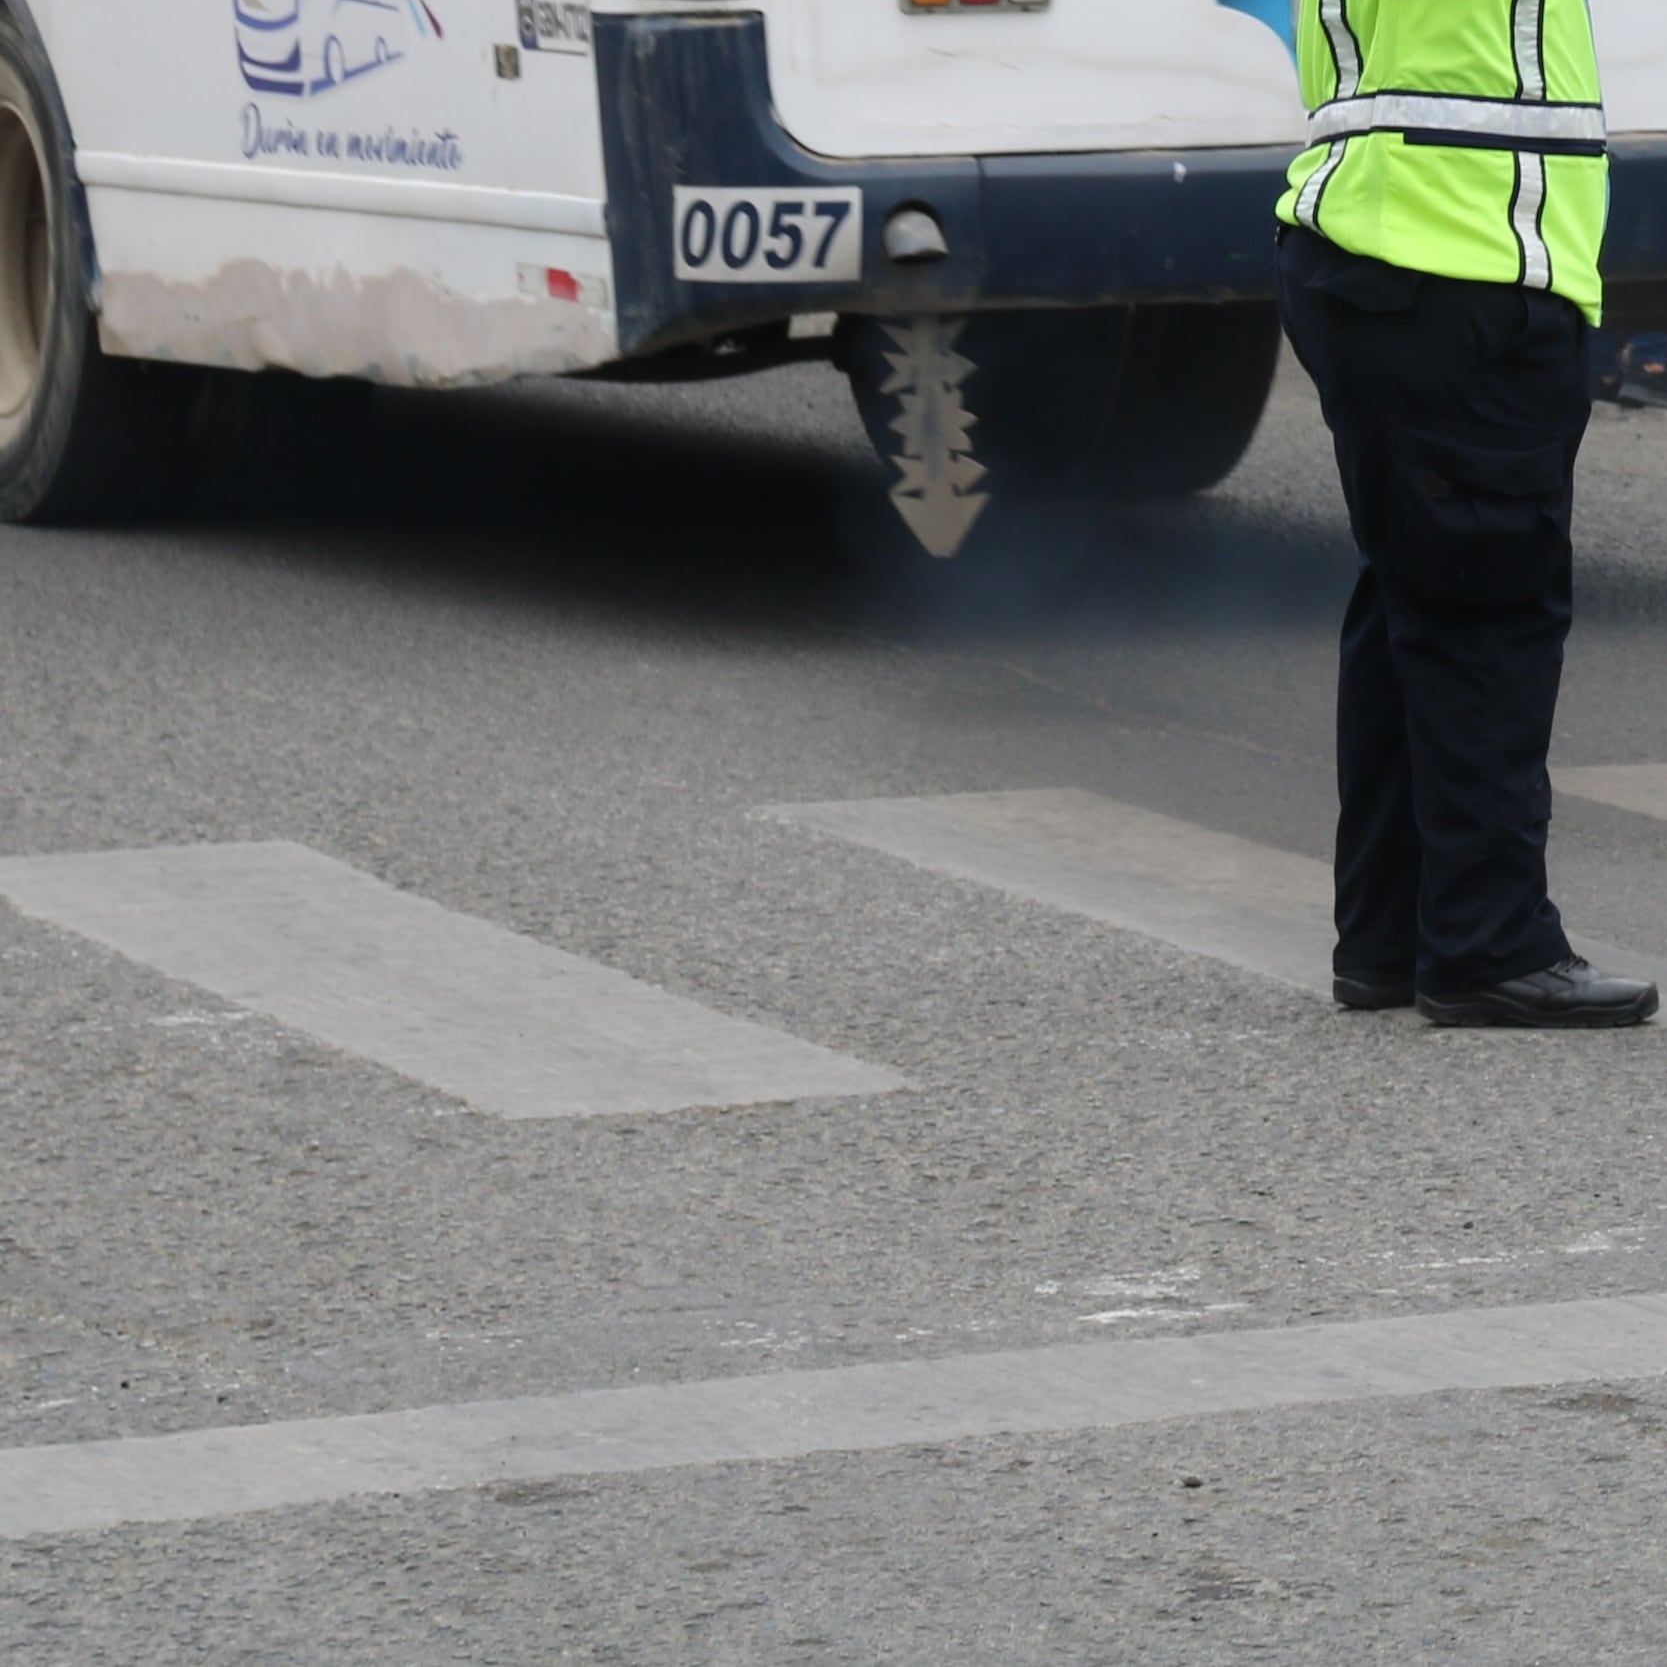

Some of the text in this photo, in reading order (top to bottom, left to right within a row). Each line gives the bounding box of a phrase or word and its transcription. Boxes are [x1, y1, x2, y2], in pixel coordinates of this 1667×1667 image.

[316, 130, 339, 159] en
[346, 124, 462, 171] movimiento
[682, 200, 852, 270] 0057
